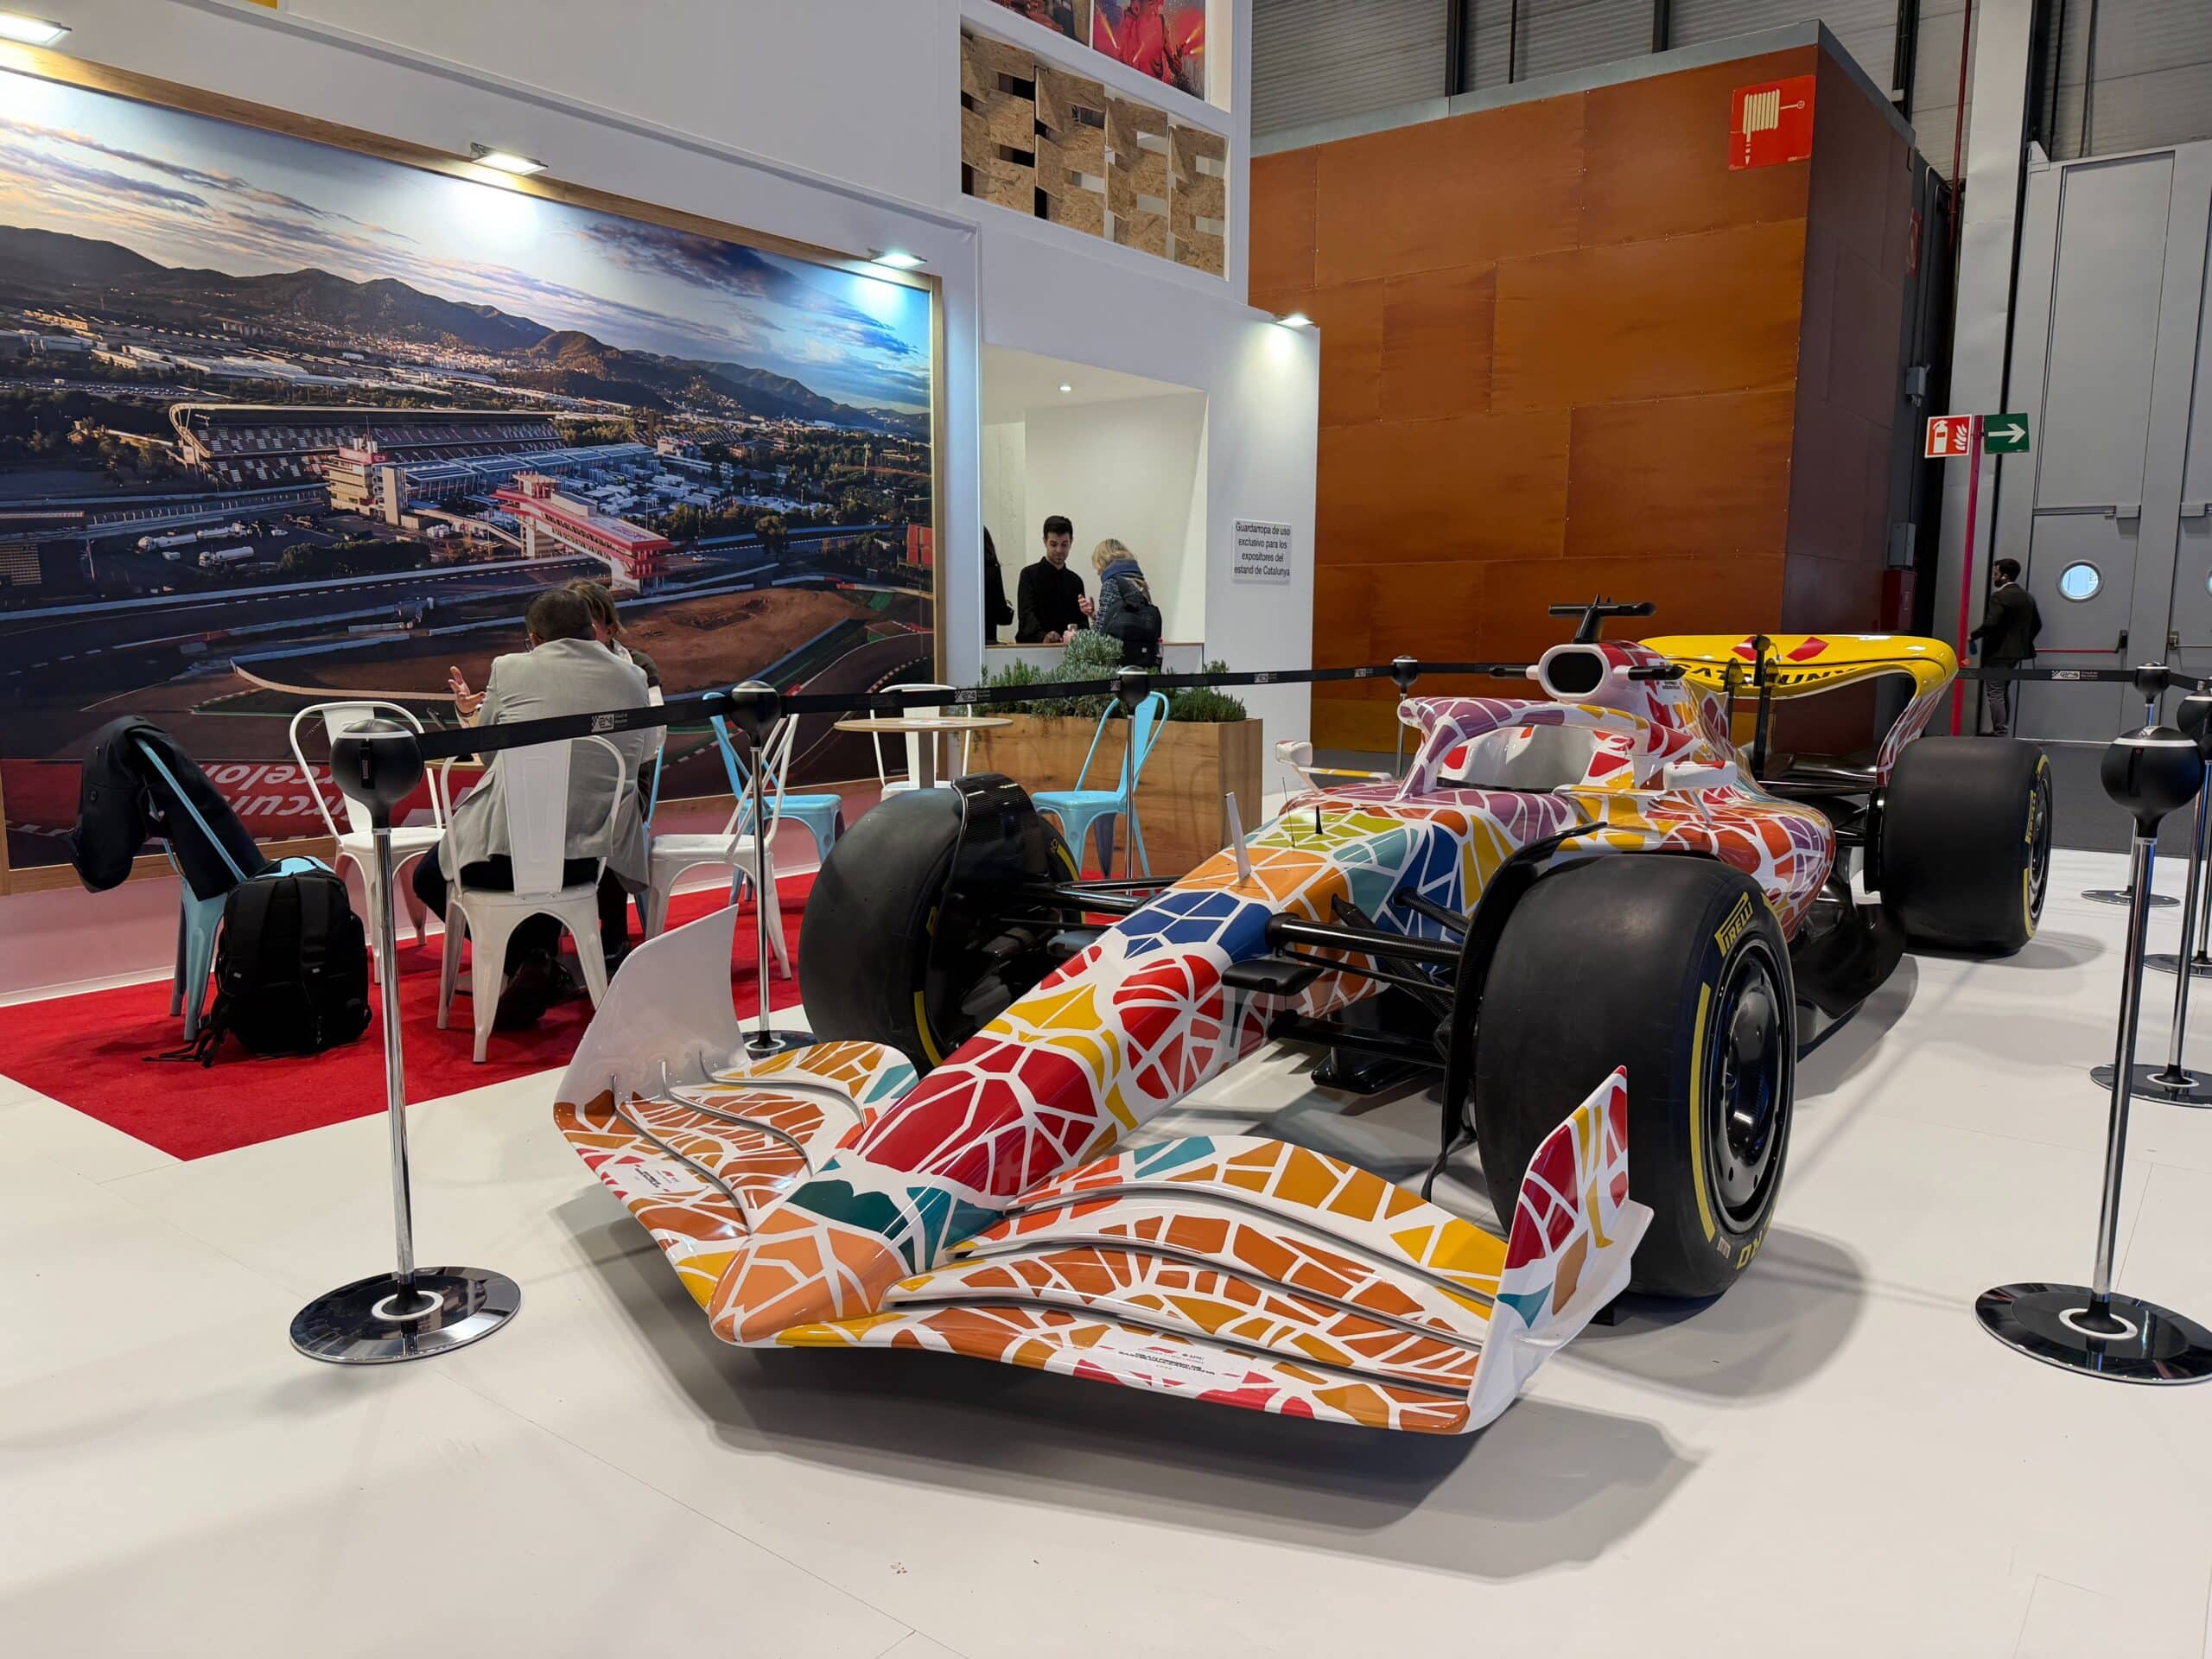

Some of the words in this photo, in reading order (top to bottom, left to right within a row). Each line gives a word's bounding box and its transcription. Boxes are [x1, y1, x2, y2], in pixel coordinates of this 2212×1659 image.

[1236, 522, 1271, 536] Guardarropa
[1272, 525, 1280, 535] de
[1238, 538, 1264, 547] exclusivo
[1265, 541, 1278, 550] para
[1279, 540, 1287, 549] los
[1242, 552, 1274, 563] expositores
[1274, 553, 1284, 563] del
[1234, 565, 1254, 574] estand
[1255, 565, 1262, 575] de
[1263, 565, 1291, 577] Catalunya
[1714, 892, 1753, 957] PIRELLI
